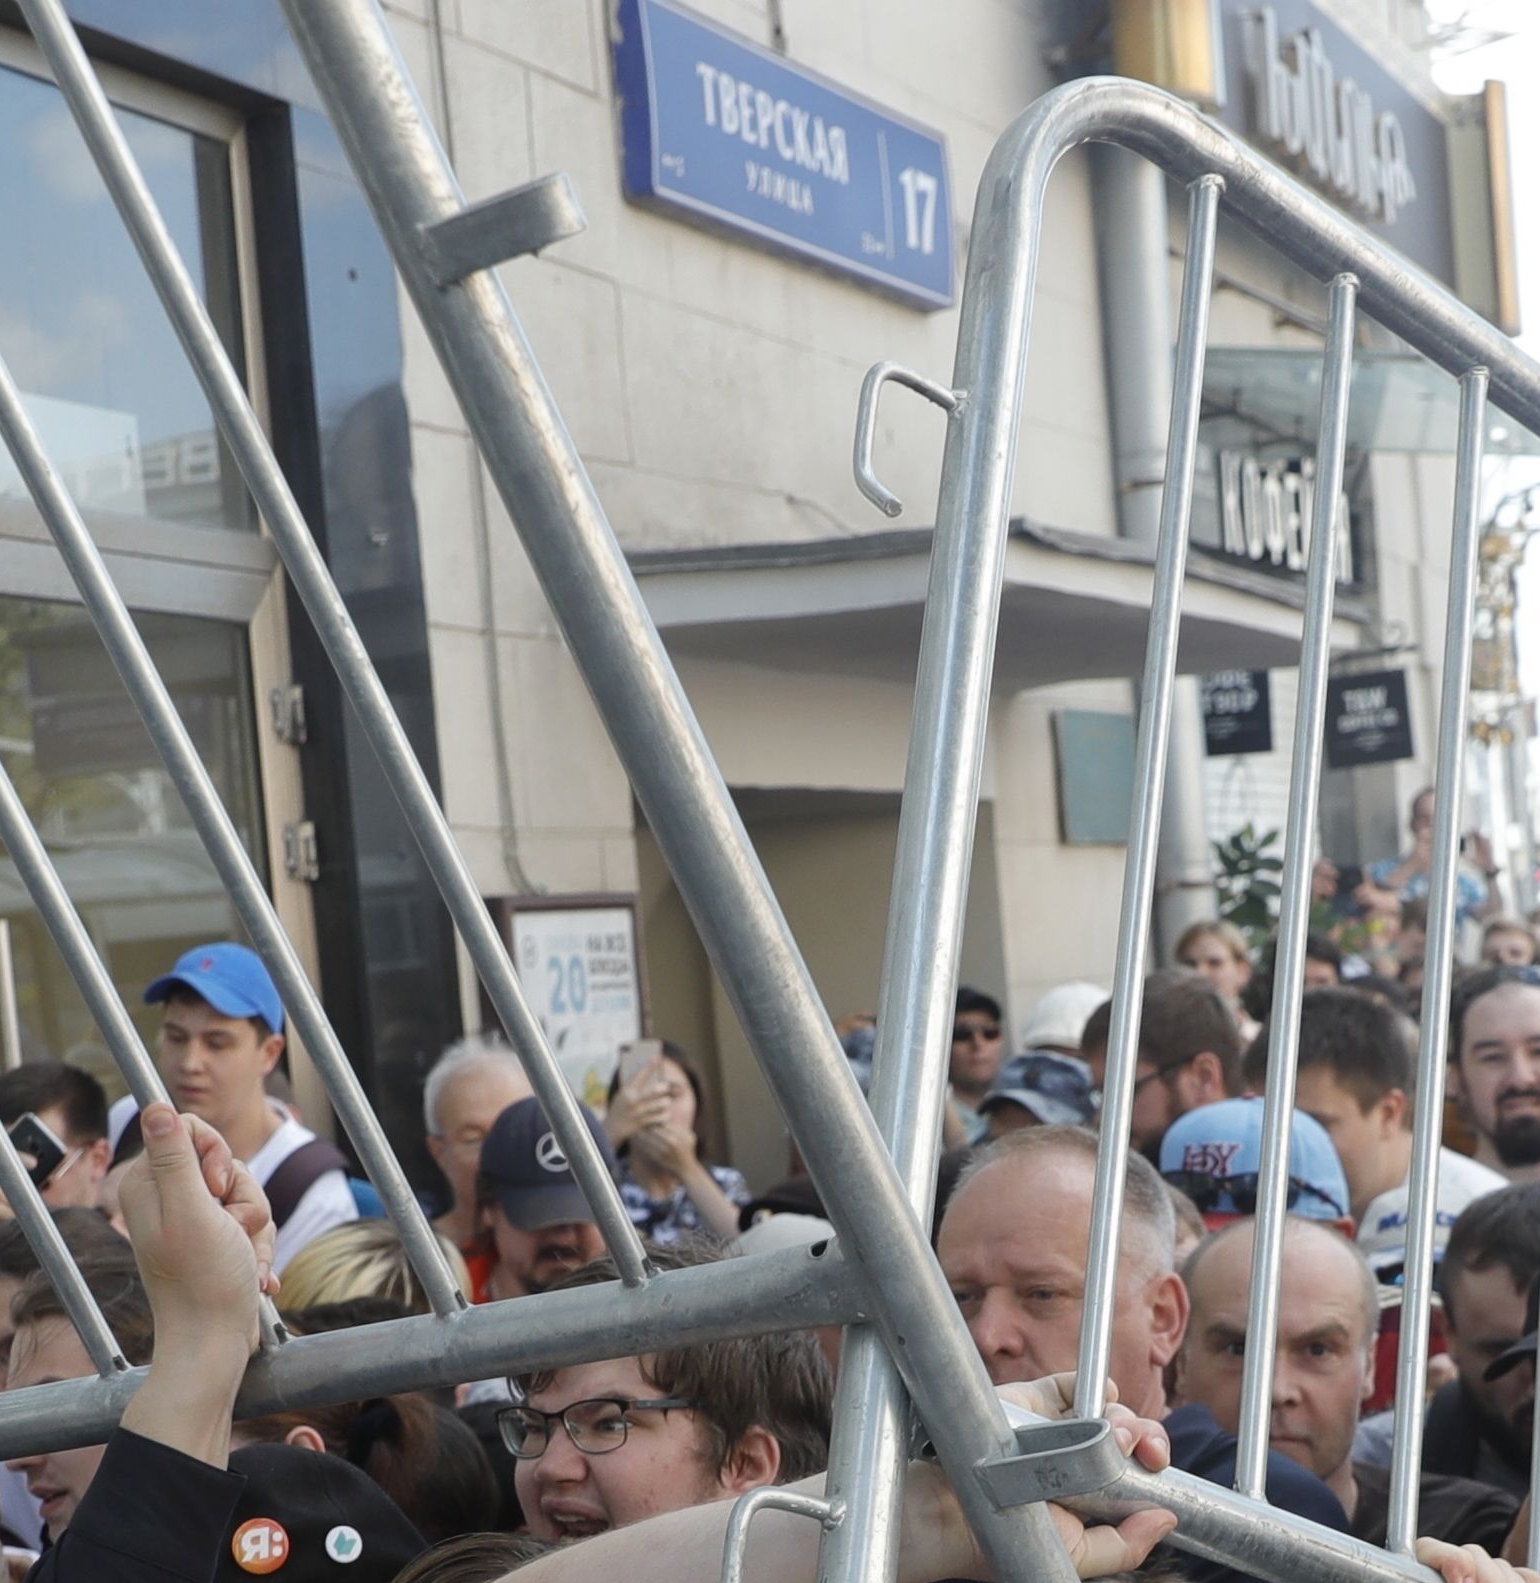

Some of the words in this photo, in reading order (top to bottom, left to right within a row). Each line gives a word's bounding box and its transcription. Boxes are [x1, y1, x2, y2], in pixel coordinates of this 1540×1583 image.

[696, 61, 850, 186] ТВЕРСКАЯ
[745, 159, 814, 217] УЛИЦА
[899, 165, 939, 256] 17
[547, 953, 588, 1015] 20
